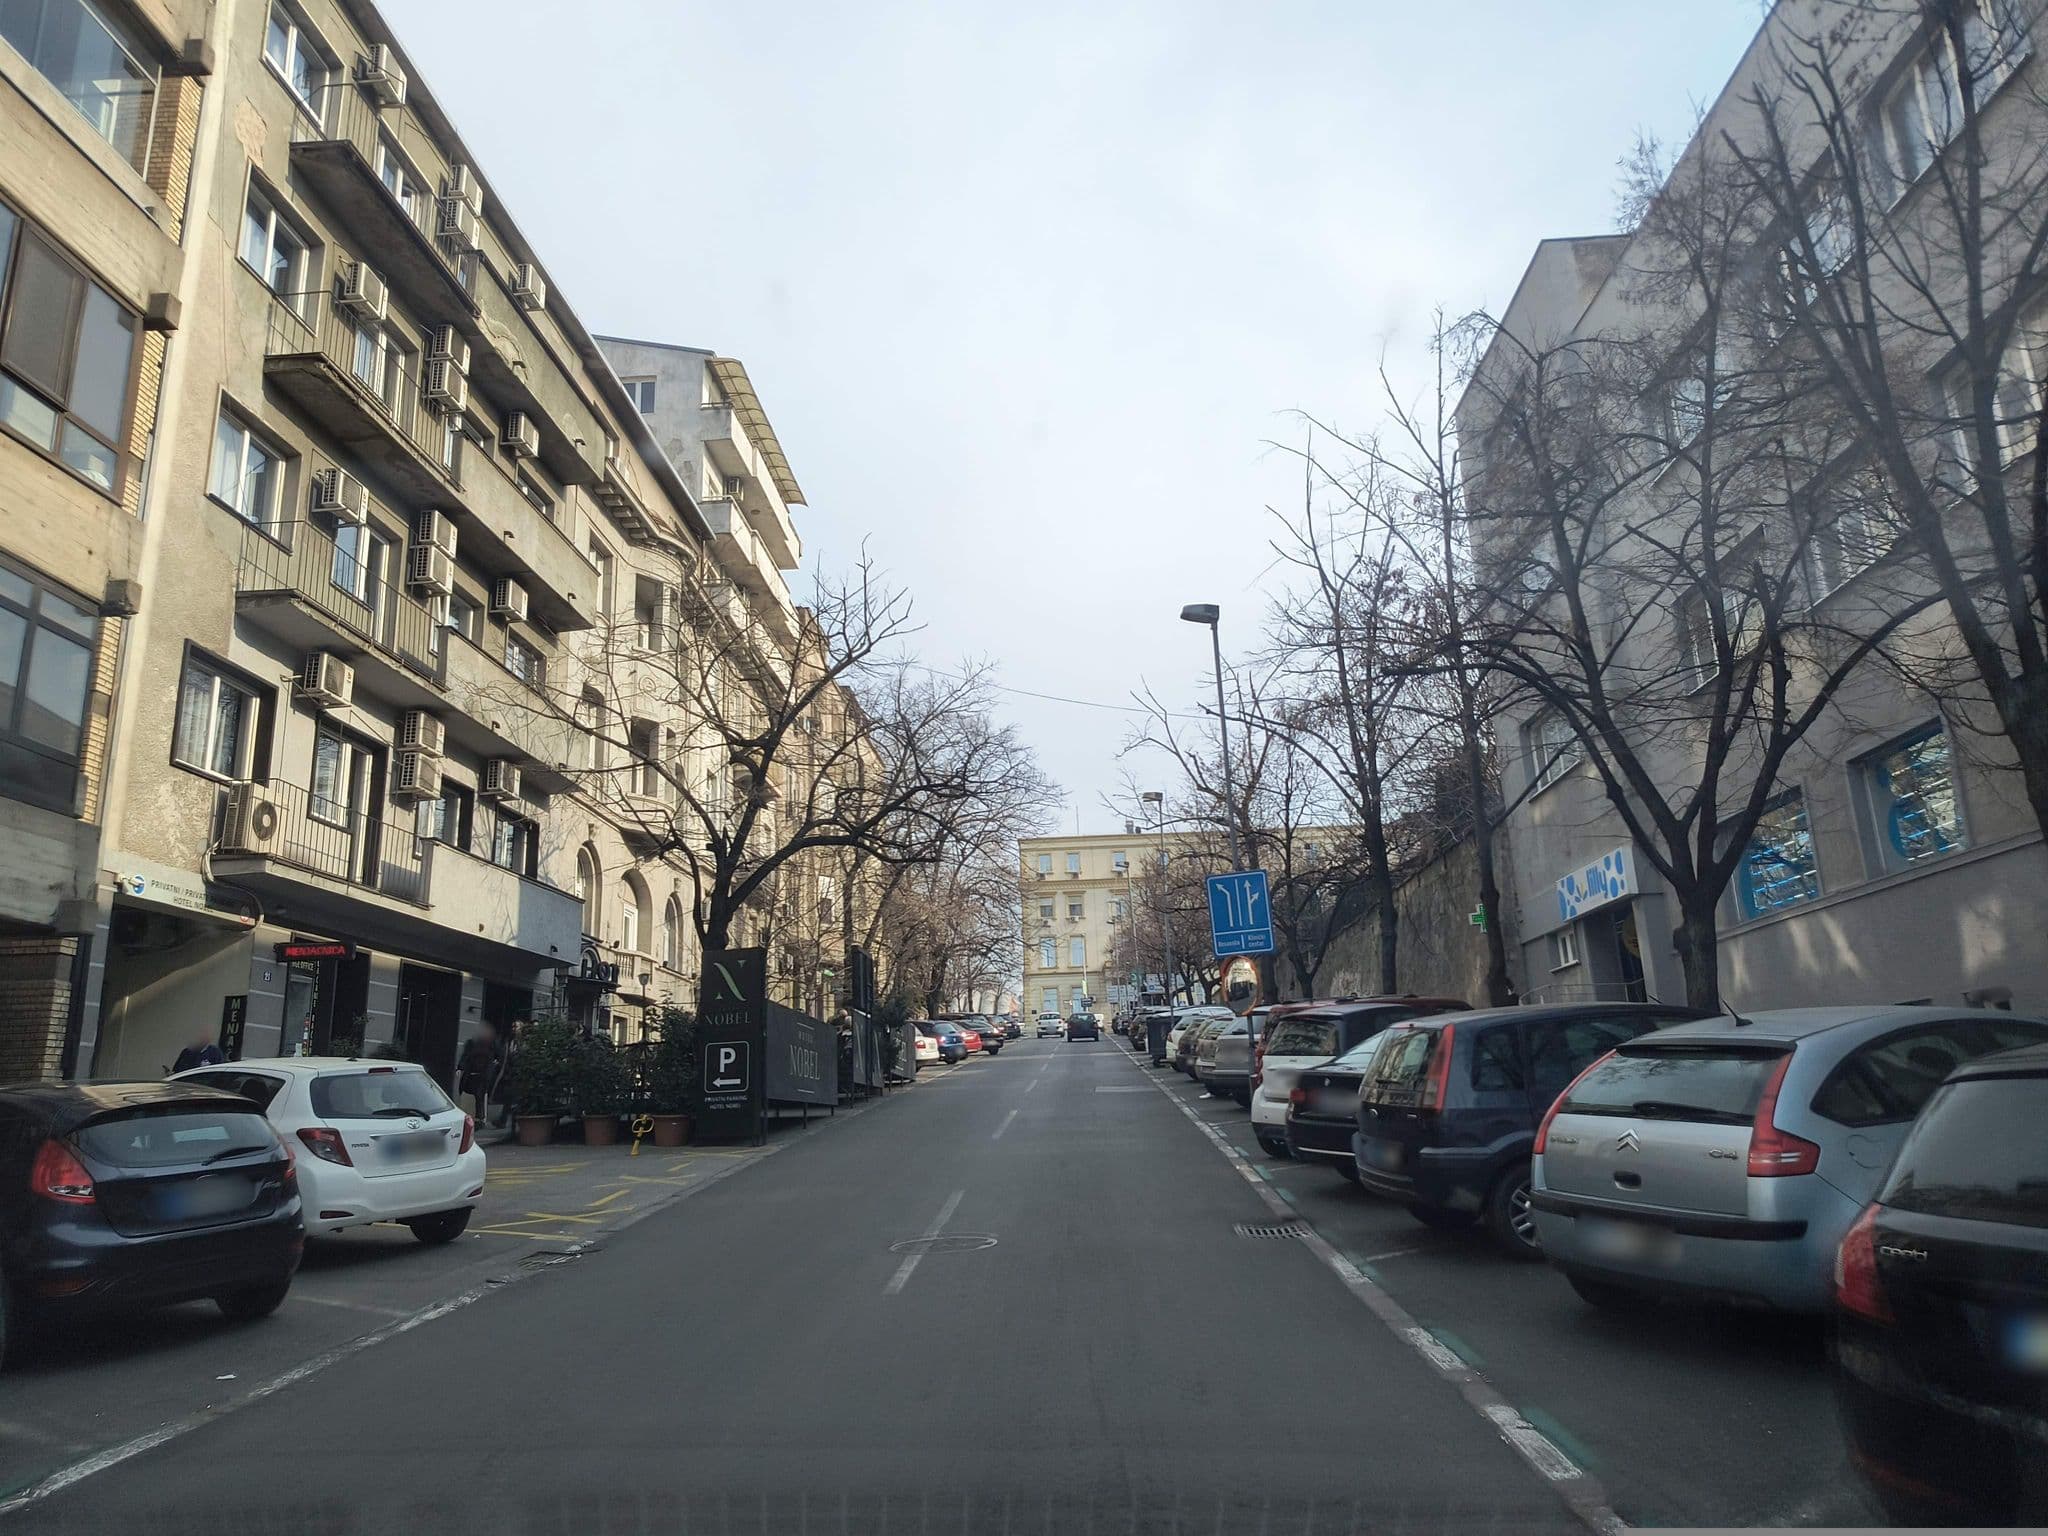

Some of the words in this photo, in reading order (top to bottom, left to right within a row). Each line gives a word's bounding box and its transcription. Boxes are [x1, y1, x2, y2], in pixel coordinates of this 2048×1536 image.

[1586, 865, 1608, 899] lilly
[174, 897, 193, 908] HOTEL
[704, 1011, 751, 1025] NOBEL
[719, 1047, 736, 1073] P
[790, 1045, 820, 1080] NOBEL
